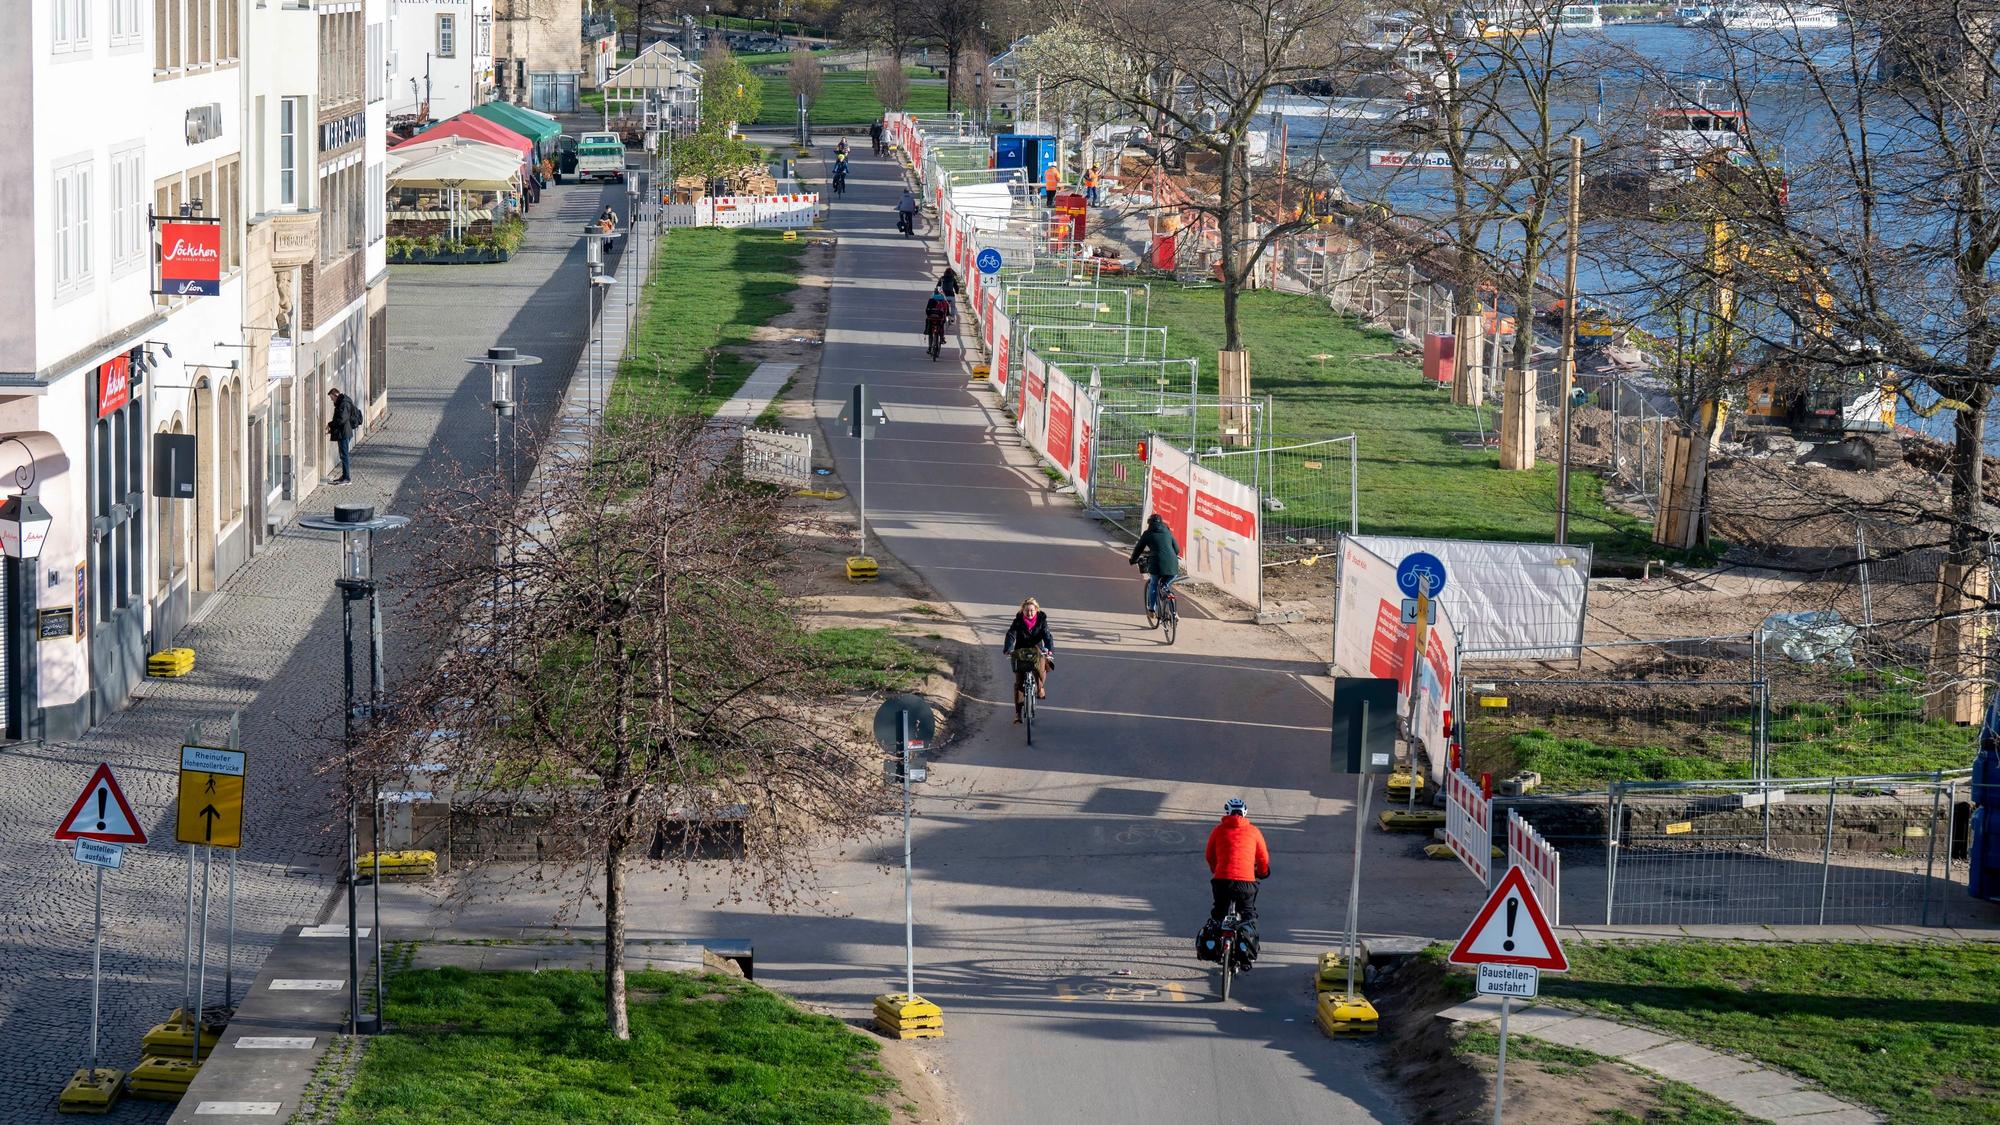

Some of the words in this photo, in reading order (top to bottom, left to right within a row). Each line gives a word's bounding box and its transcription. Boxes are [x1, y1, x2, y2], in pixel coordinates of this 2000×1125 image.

[195, 751, 232, 762] Rheinufer
[184, 759, 240, 772] Hohenzollerbrücke
[81, 841, 118, 855] Baustellen-
[84, 853, 112, 864] ausfahrt
[1482, 966, 1533, 980] Baustellen-
[1487, 981, 1526, 993] ausfahrt
